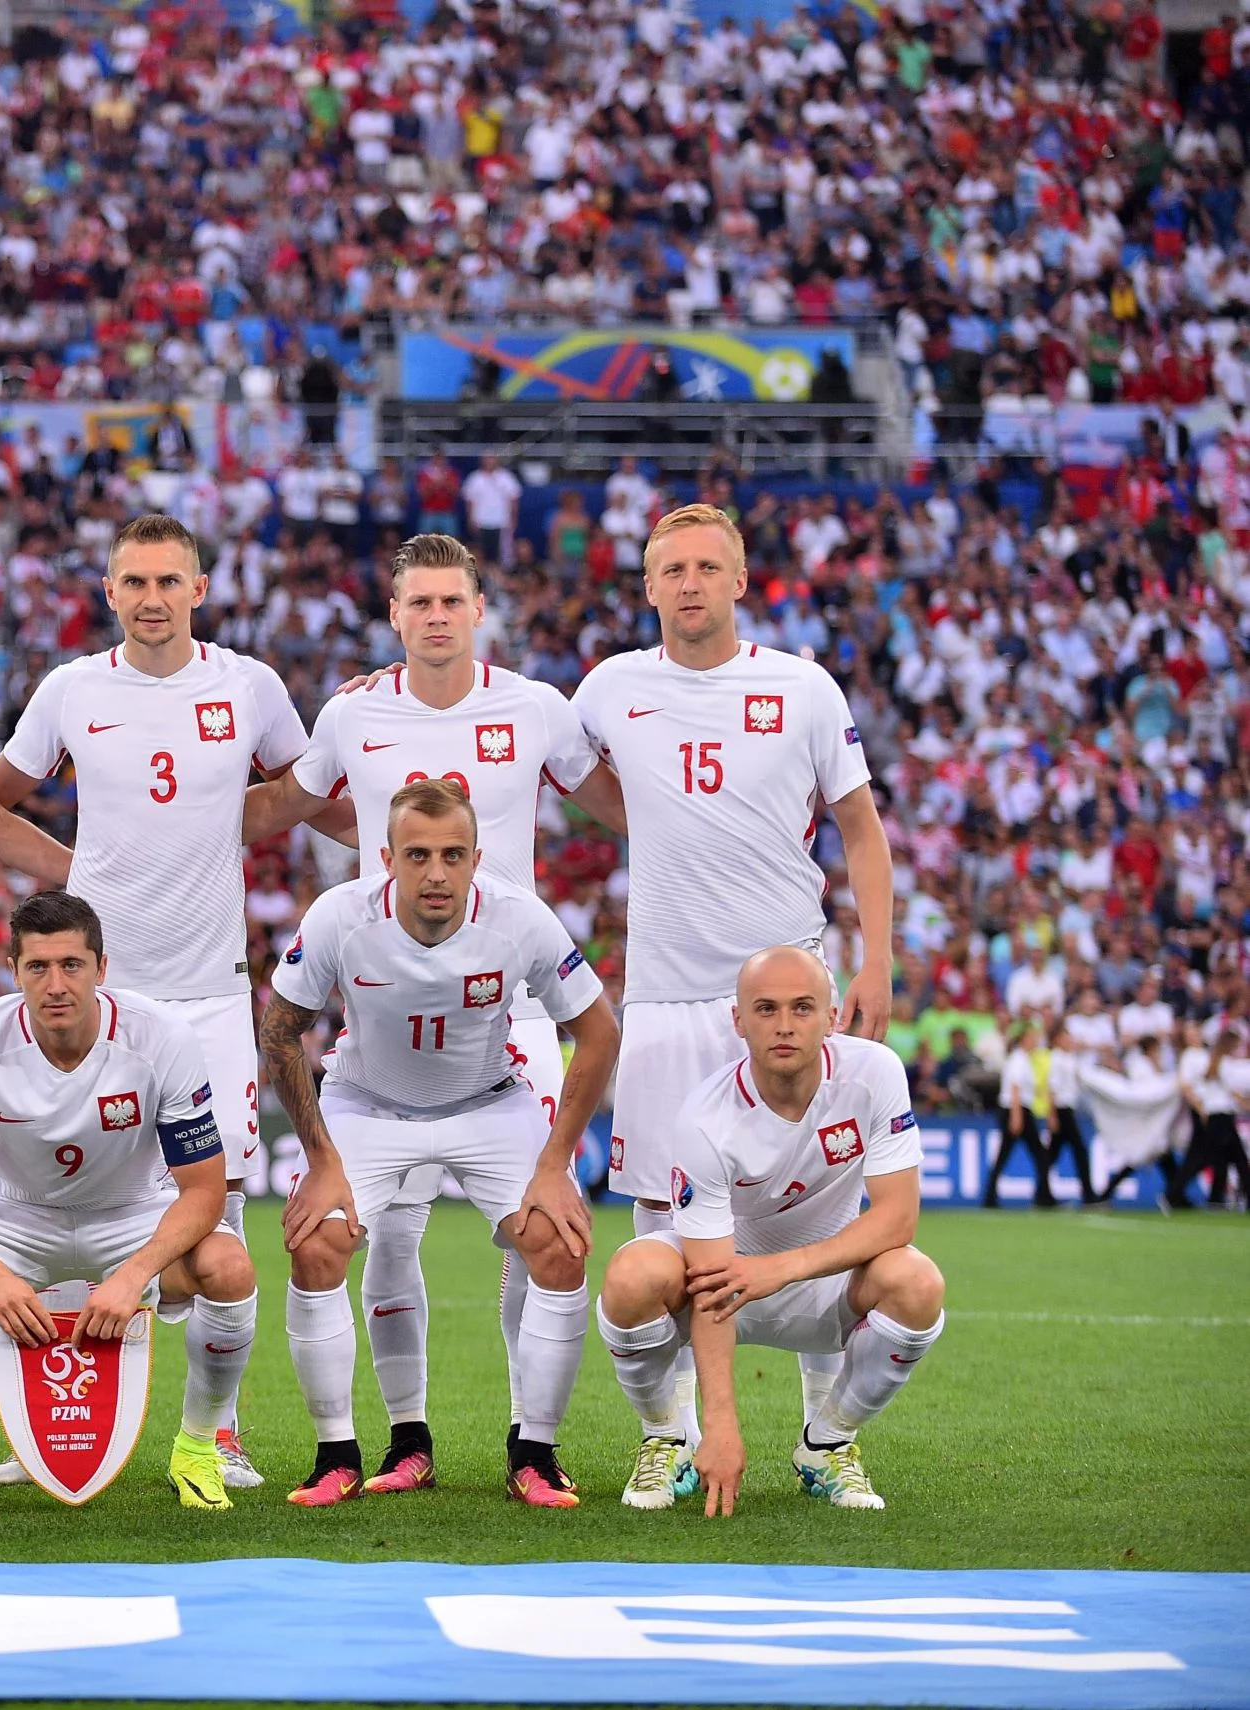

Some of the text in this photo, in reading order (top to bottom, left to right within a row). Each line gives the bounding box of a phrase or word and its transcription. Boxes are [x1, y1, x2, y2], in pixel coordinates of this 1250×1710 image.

[150, 751, 177, 804] 3
[679, 742, 724, 795] 15
[407, 1014, 445, 1050] 11
[245, 1081, 258, 1135] 3
[174, 1131, 188, 1140] NO
[188, 1127, 200, 1136] TO
[55, 1144, 84, 1177] 9
[775, 1180, 806, 1213] 2
[51, 1405, 91, 1421] PZPN
